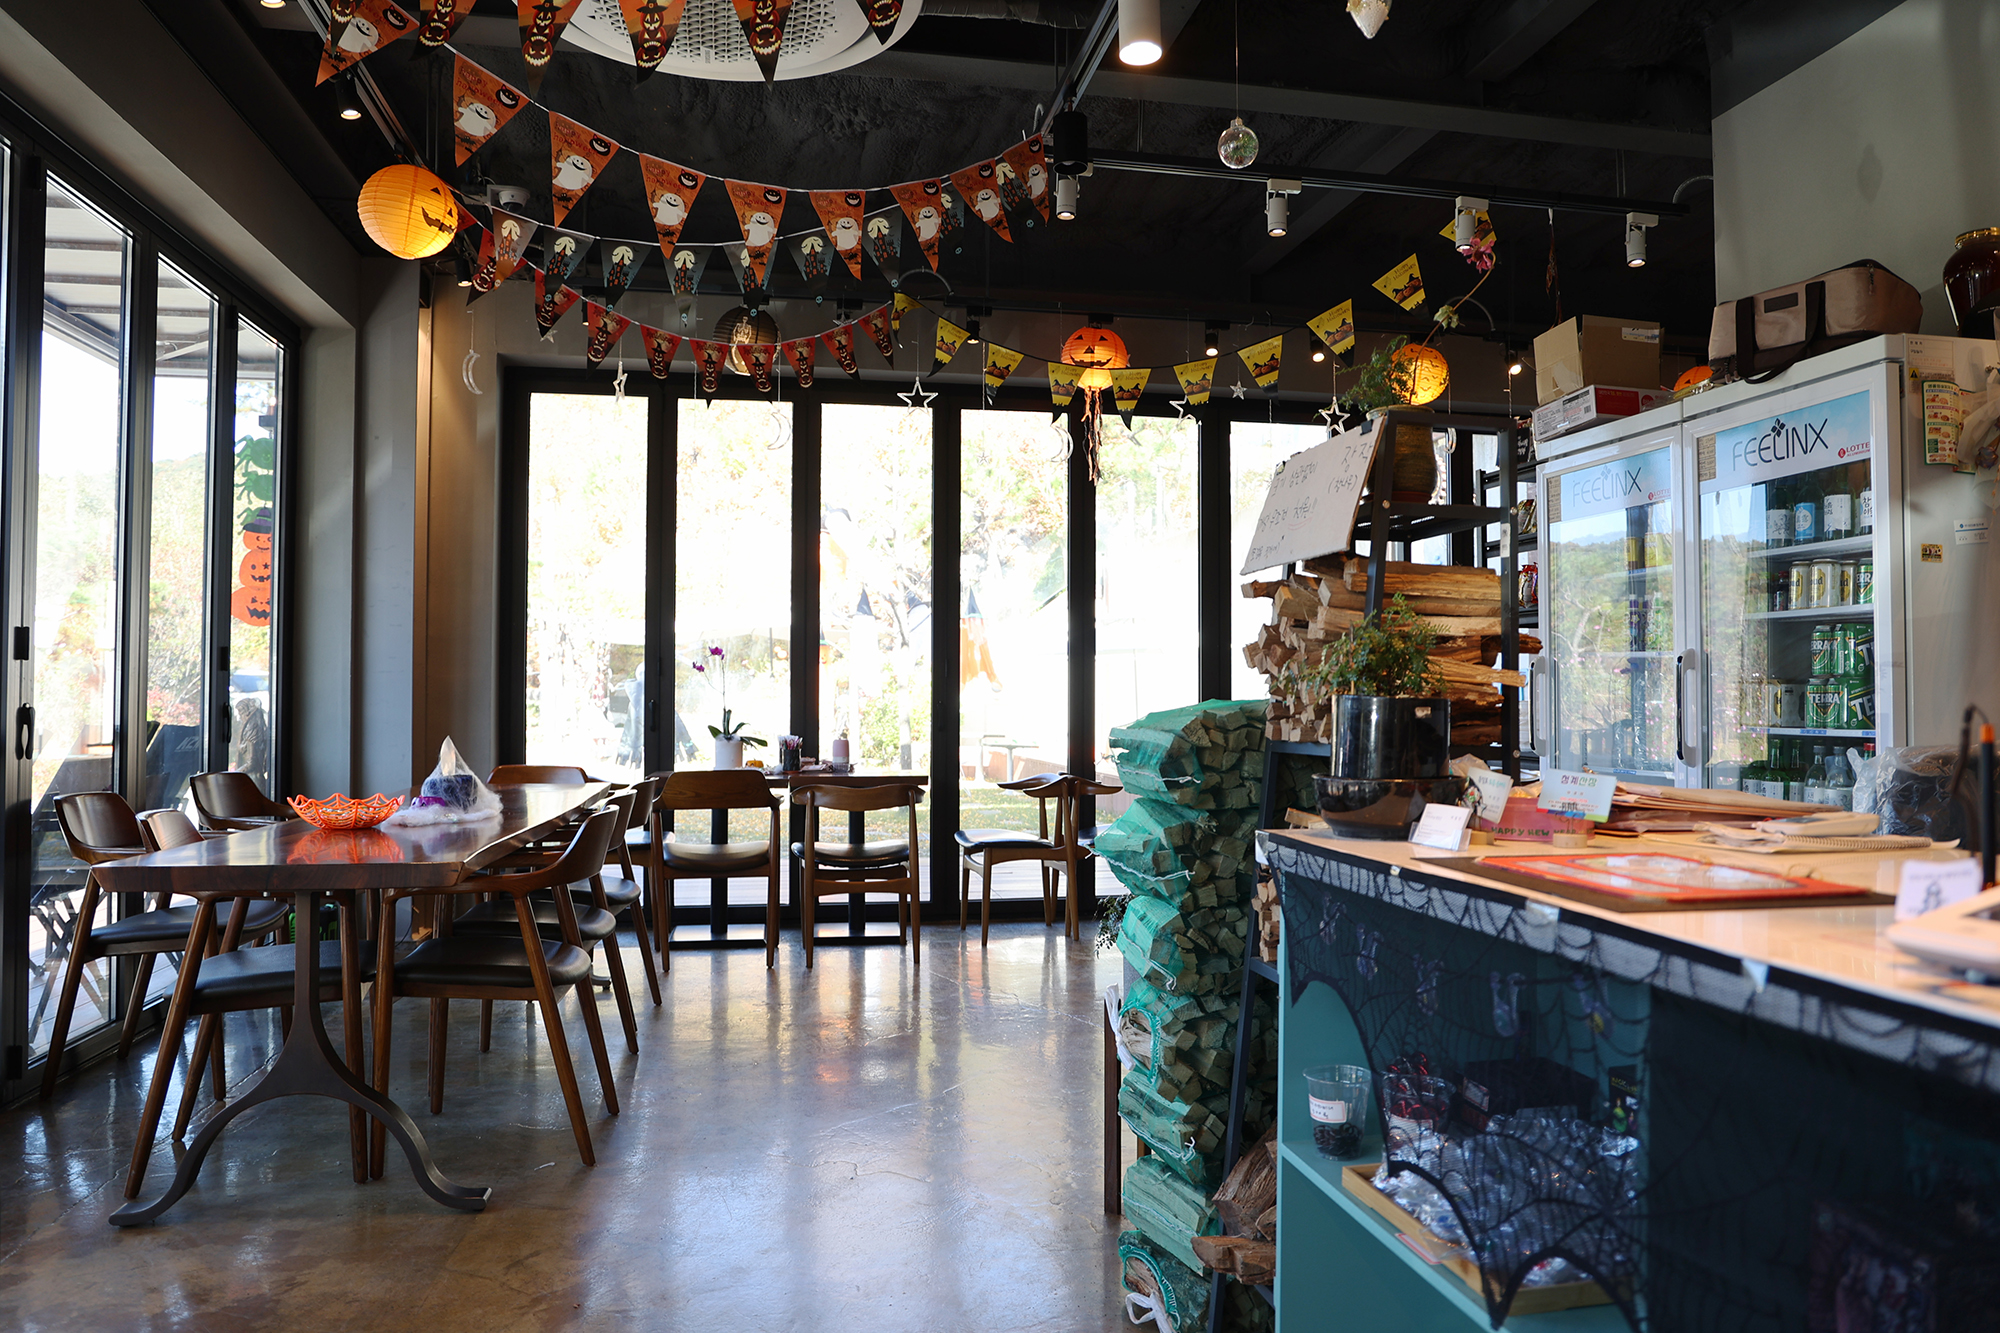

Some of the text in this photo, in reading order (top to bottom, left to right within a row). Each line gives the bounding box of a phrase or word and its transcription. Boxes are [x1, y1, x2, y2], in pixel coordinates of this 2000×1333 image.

[1341, 442, 1373, 473] 장작
[1732, 418, 1829, 471] FEELINX
[1846, 441, 1870, 452] LOTTE
[1573, 467, 1642, 508] FEELINX
[1491, 827, 1525, 837] HAPPY
